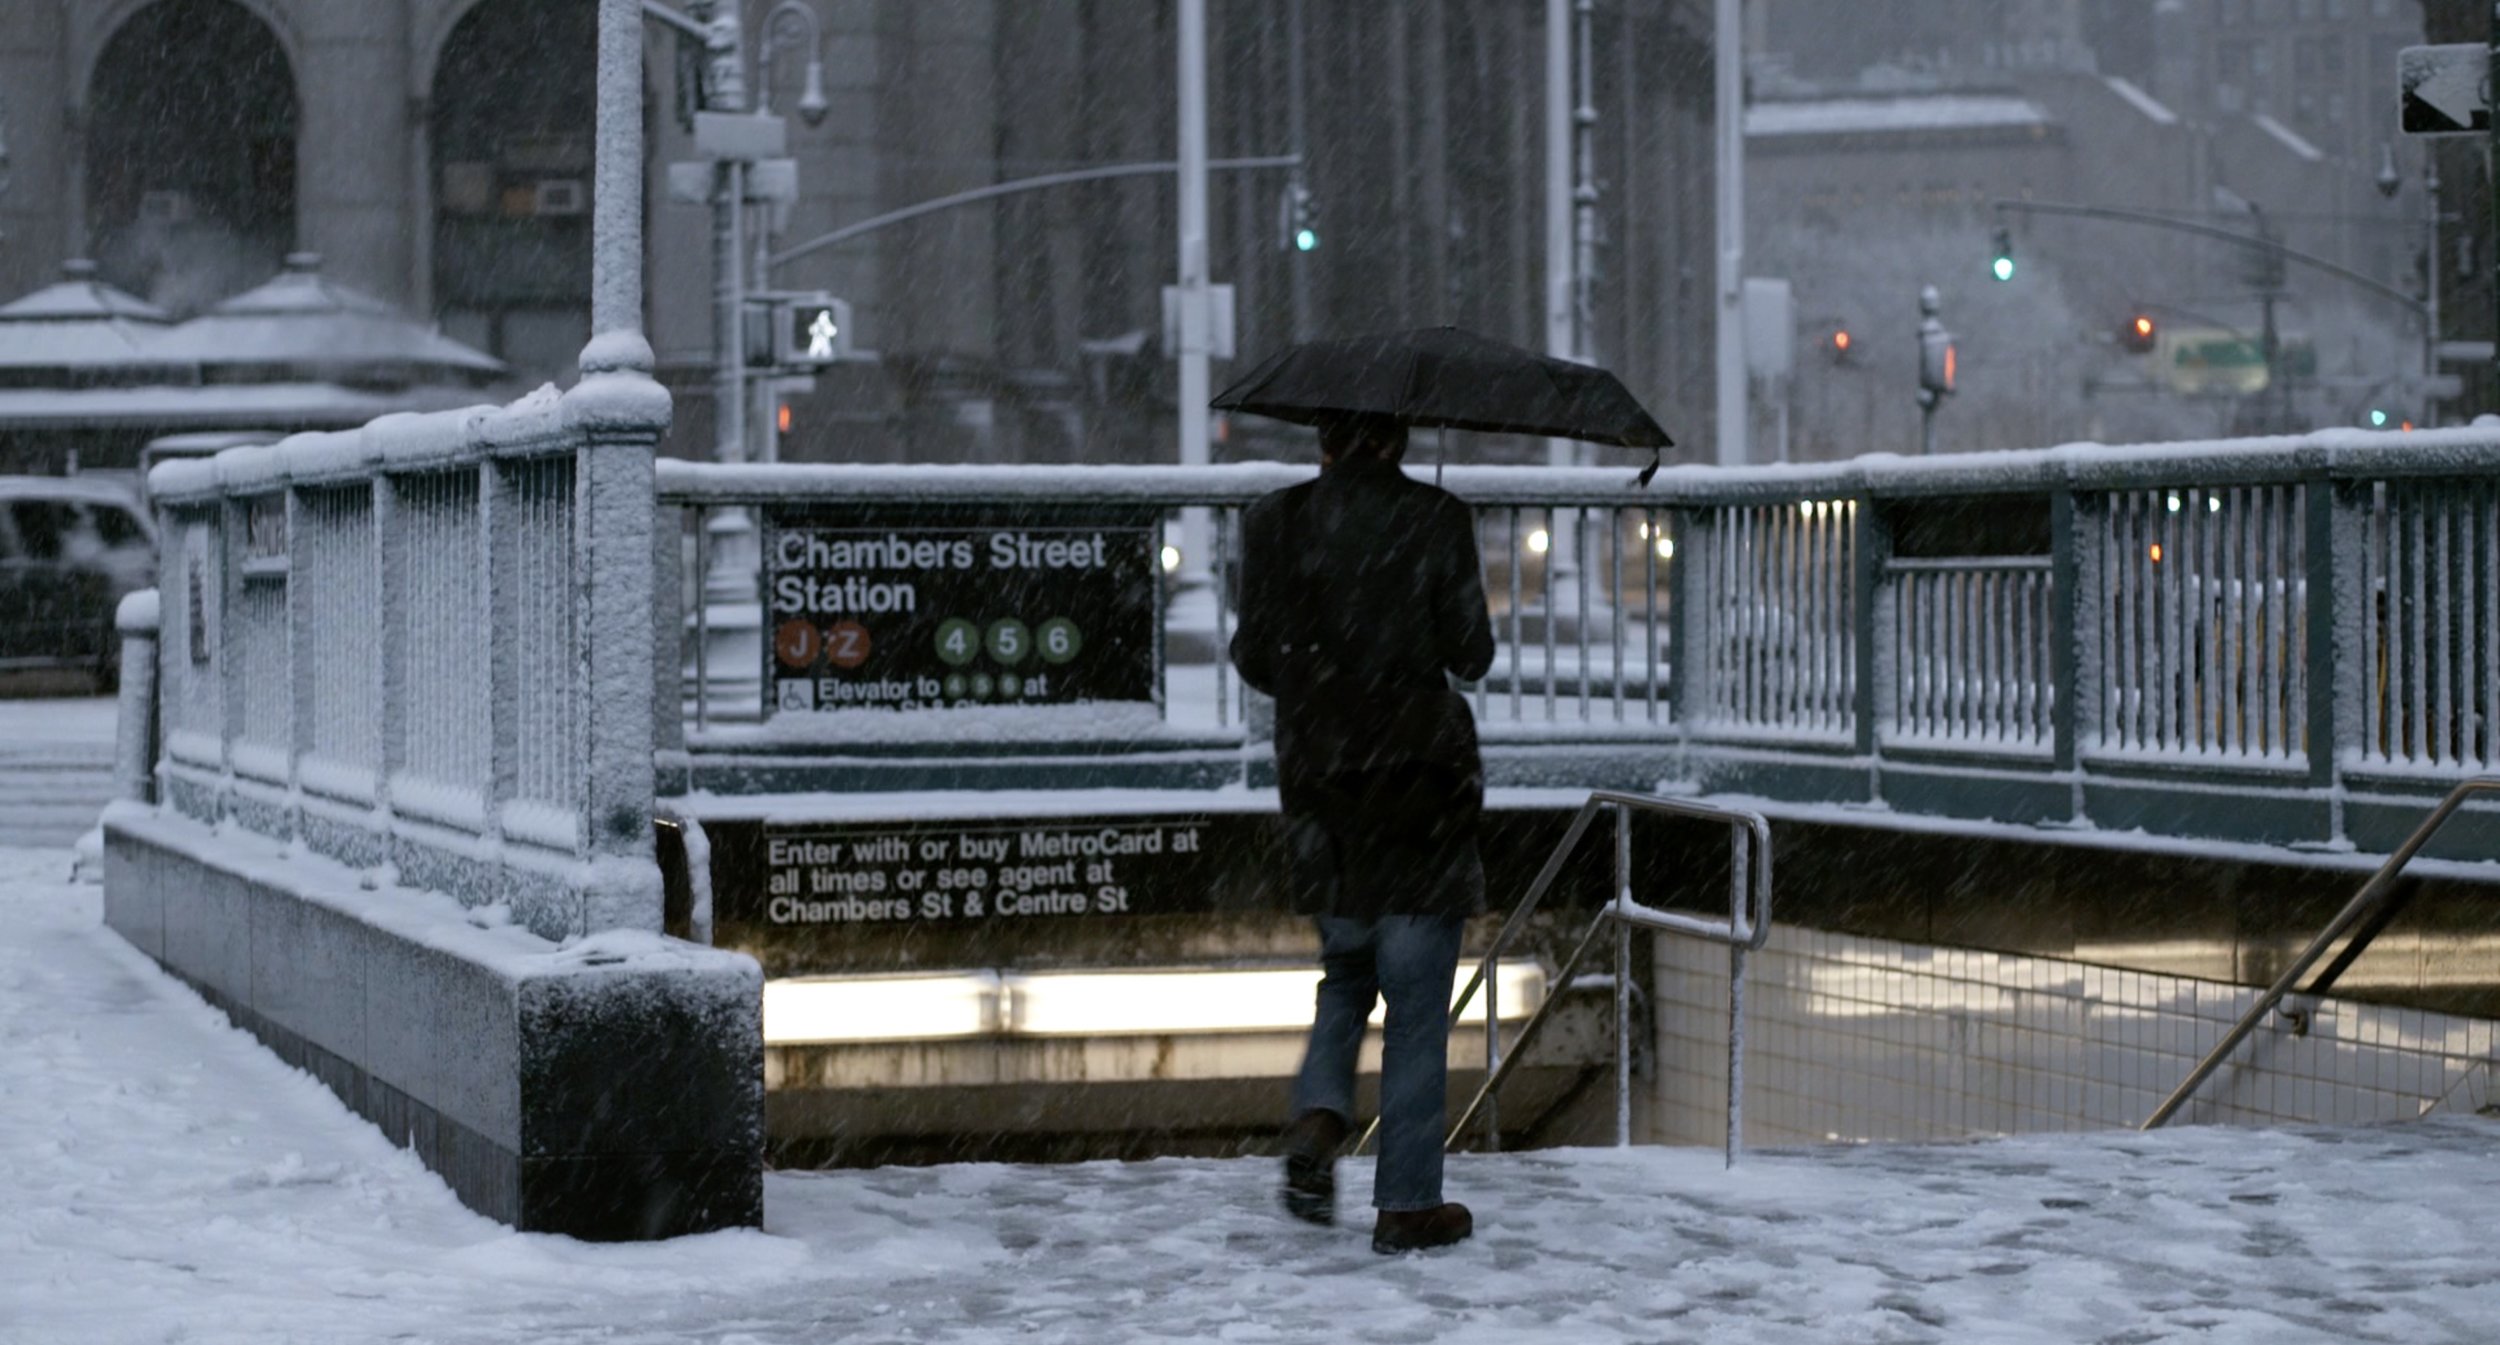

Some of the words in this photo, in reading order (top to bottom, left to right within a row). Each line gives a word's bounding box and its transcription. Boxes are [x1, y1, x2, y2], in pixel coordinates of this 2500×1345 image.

[777, 532, 974, 570] Chambers
[989, 531, 1107, 569] Street
[776, 575, 916, 613] Station
[790, 629, 808, 658] J
[838, 630, 859, 658] Z
[946, 627, 967, 655] 4
[998, 628, 1018, 655] 5
[1048, 627, 1069, 654] 6
[818, 677, 912, 701] Elevator
[916, 675, 941, 698] to
[1023, 673, 1048, 697] at
[769, 838, 842, 866] Enter
[852, 835, 910, 864] with
[920, 839, 951, 863] or
[959, 833, 1009, 864] buy
[1020, 827, 1163, 858] MetroCard
[1172, 827, 1199, 853] at
[769, 869, 799, 894] all
[811, 867, 887, 893] times
[897, 868, 925, 889] or
[936, 867, 988, 889] see
[998, 859, 1076, 892] agent
[1086, 859, 1114, 884] at
[768, 895, 911, 924] Chambers
[920, 891, 953, 920] St
[963, 890, 985, 918] &
[995, 887, 1087, 917] Centre
[1097, 884, 1130, 913] St
